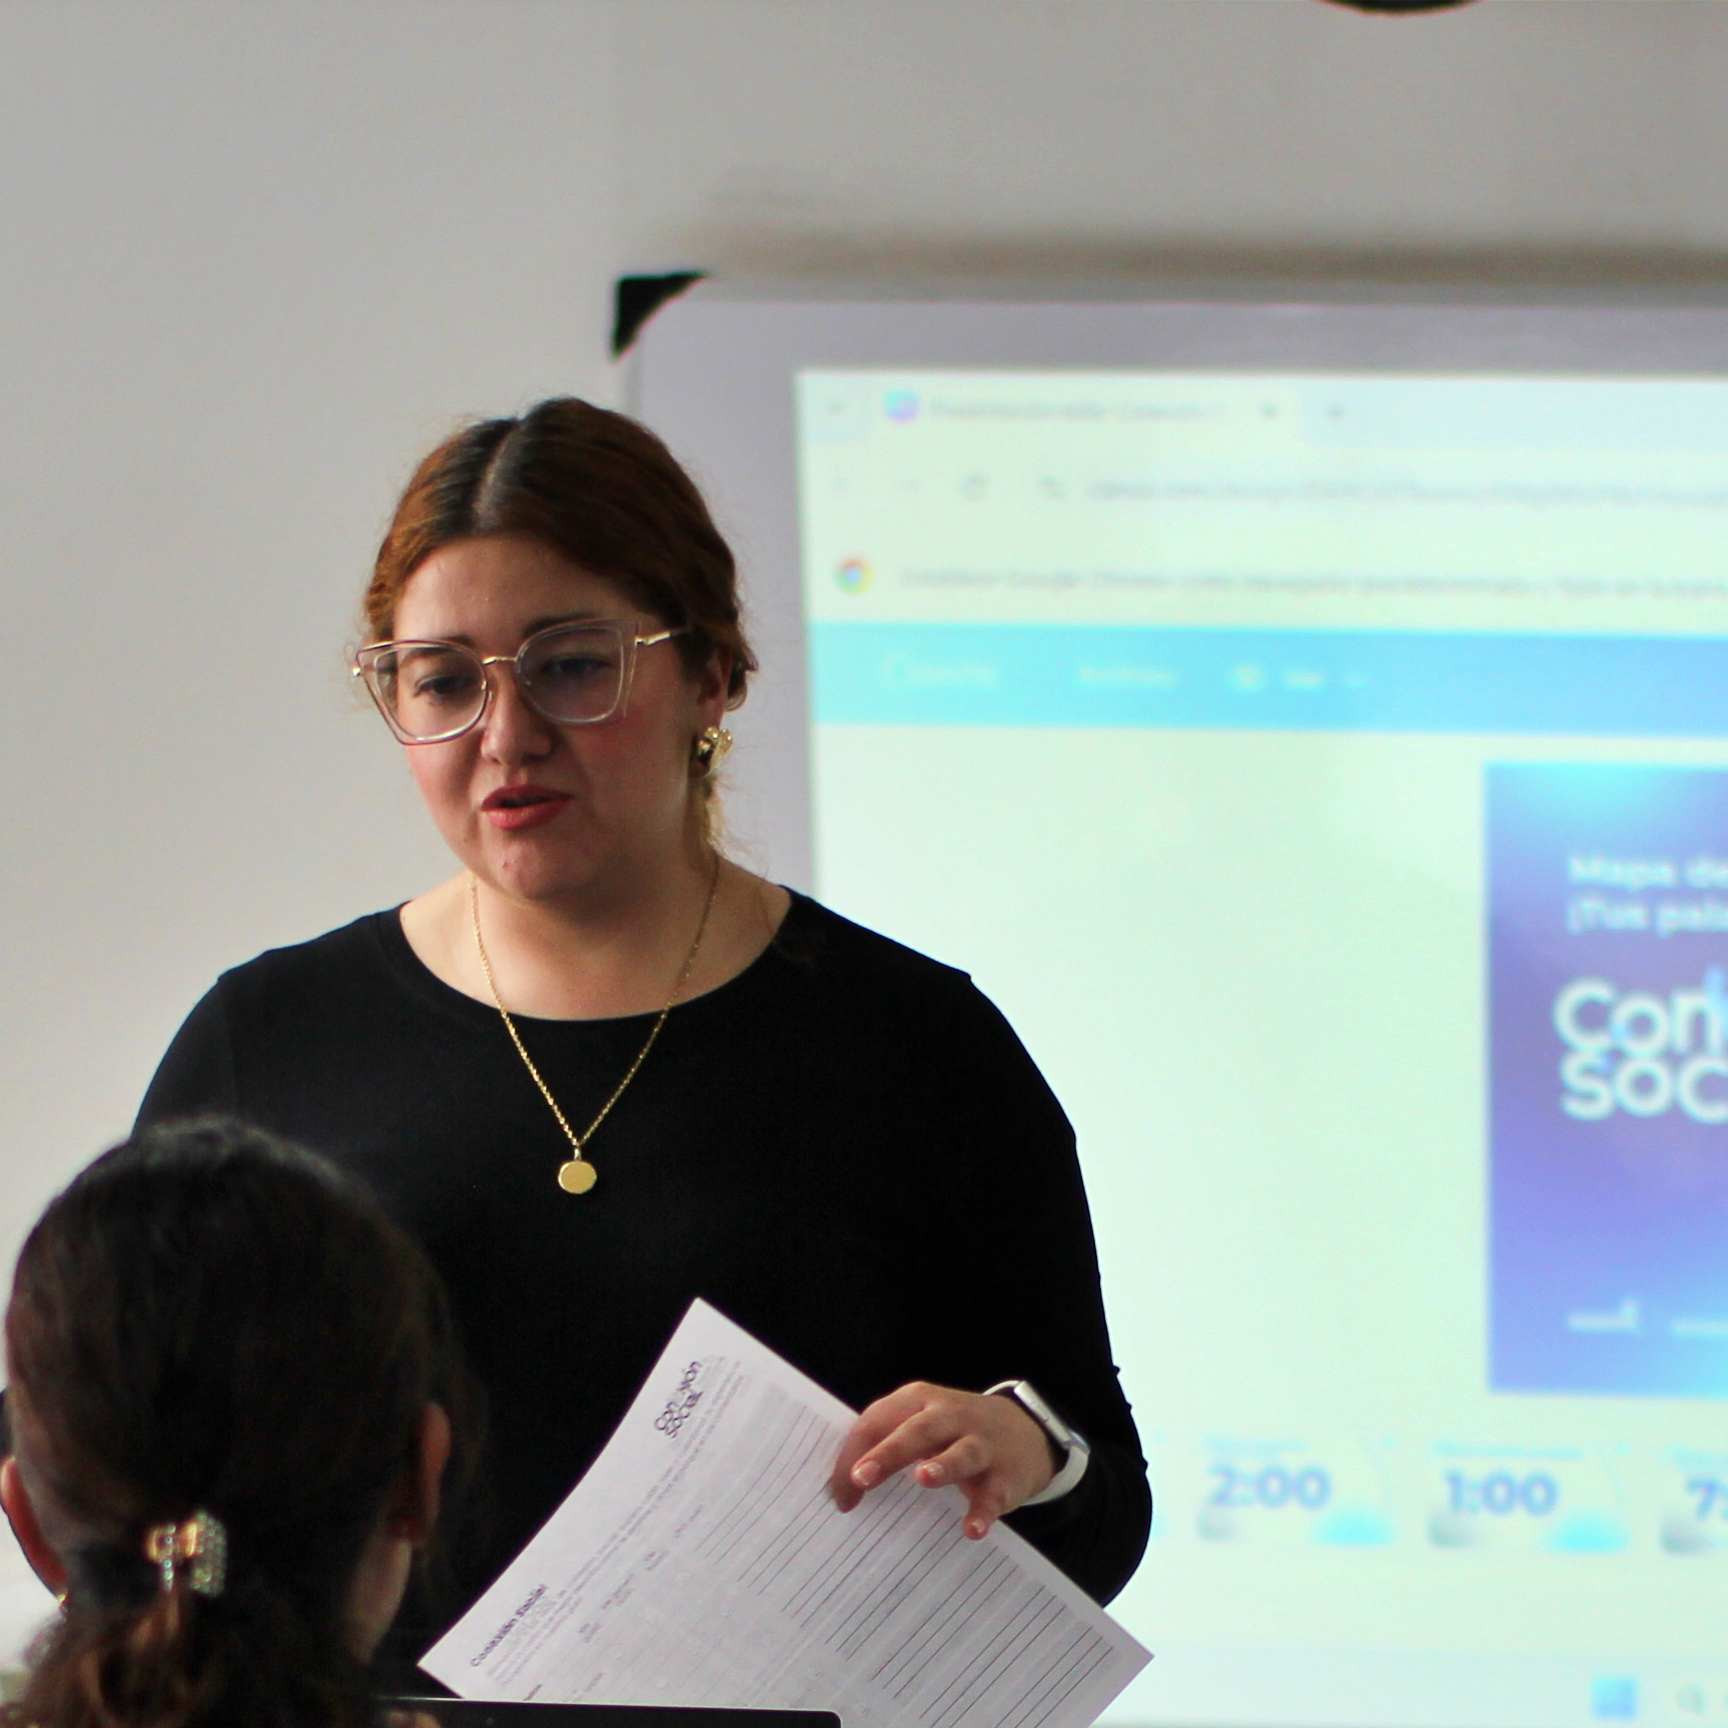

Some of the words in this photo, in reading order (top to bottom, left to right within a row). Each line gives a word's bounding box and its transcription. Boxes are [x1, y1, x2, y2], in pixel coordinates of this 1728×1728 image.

[1569, 856, 1677, 891] Mapa
[1206, 1463, 1331, 1510] 2:00
[1444, 1469, 1559, 1517] 1:00
